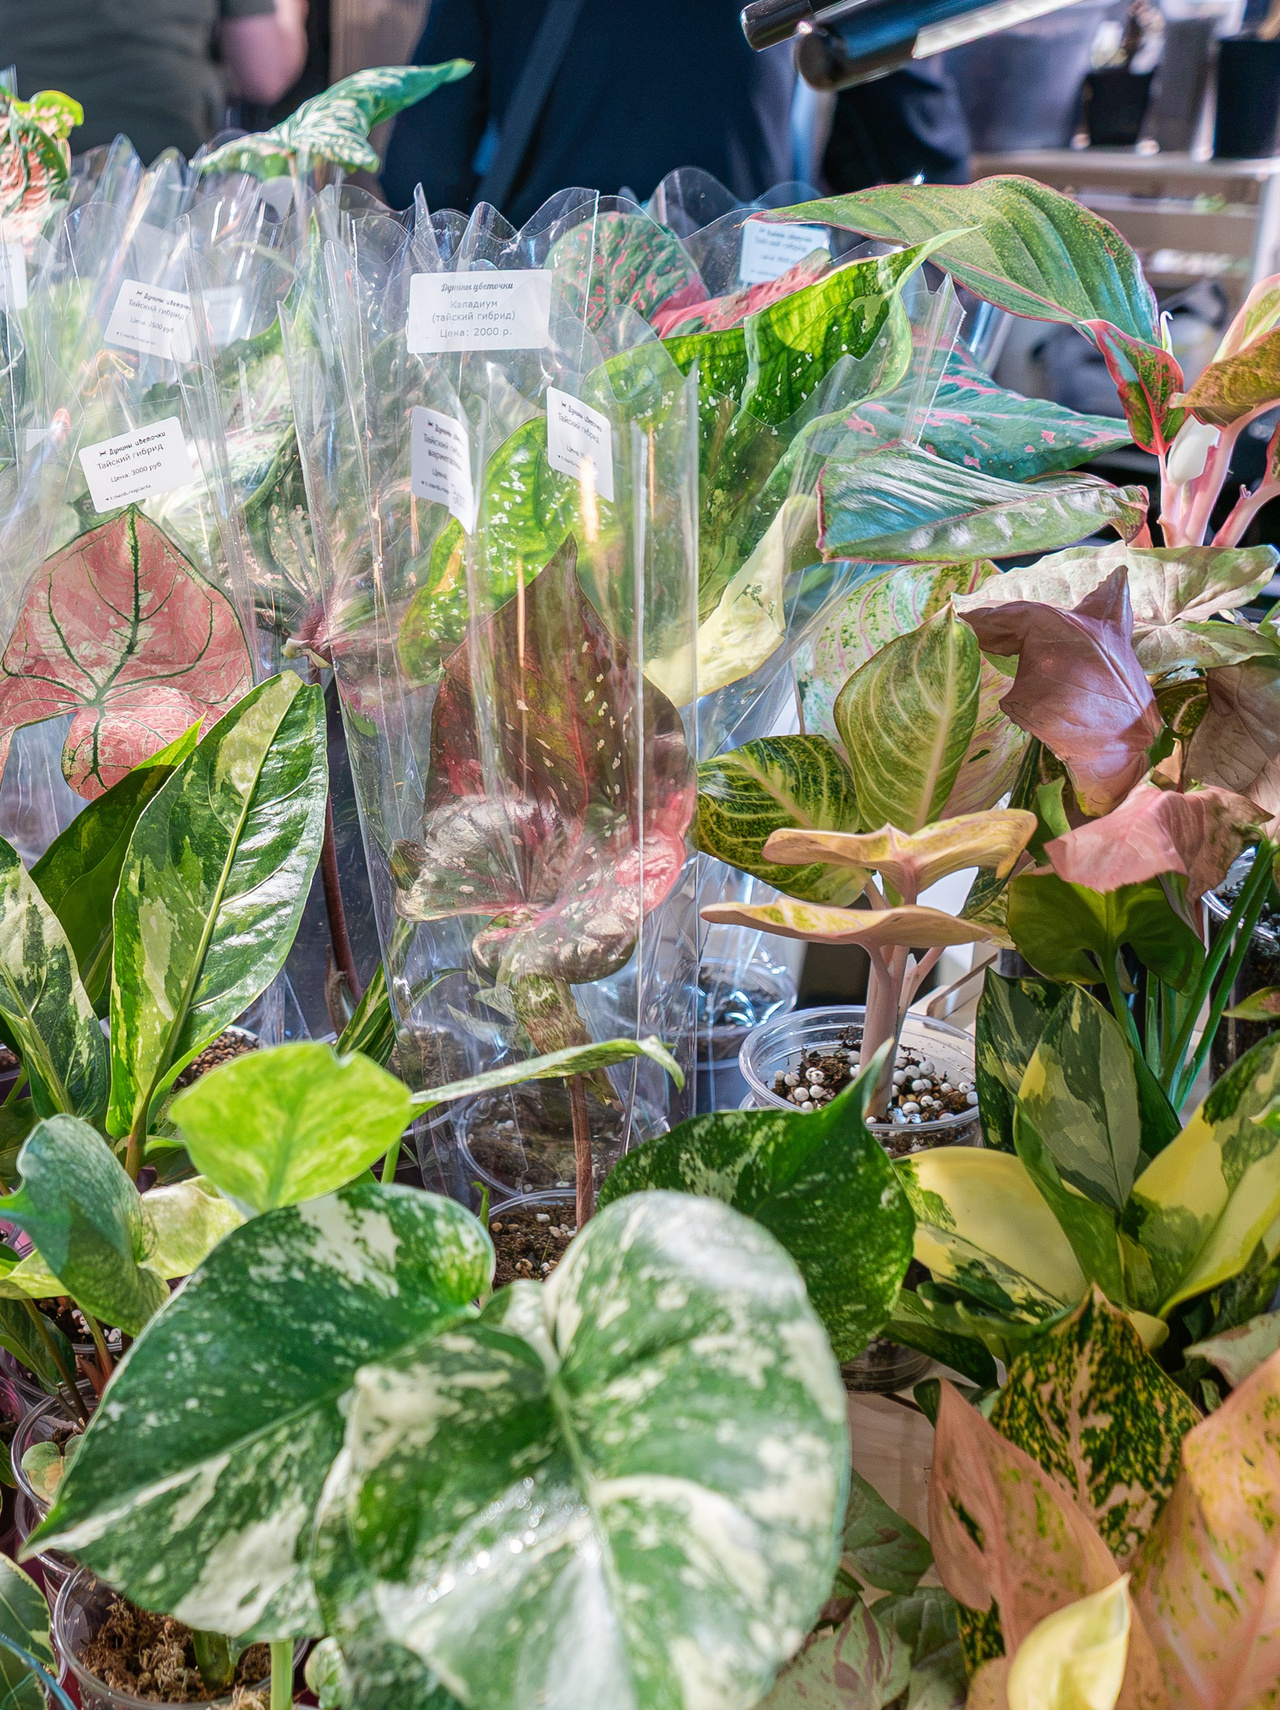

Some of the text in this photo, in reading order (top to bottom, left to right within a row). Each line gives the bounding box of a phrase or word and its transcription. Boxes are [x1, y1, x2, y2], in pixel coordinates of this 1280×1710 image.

[441, 282, 513, 294] Дунины цветочки
[450, 300, 498, 310] Каладиум
[432, 310, 516, 324] (тайский гибрид)
[440, 327, 512, 339] Цена: 2000 р.
[109, 432, 166, 455] Дунины цветочки
[97, 443, 164, 470] Тайский гибрид
[110, 461, 162, 483] Цена: 3000 руб
